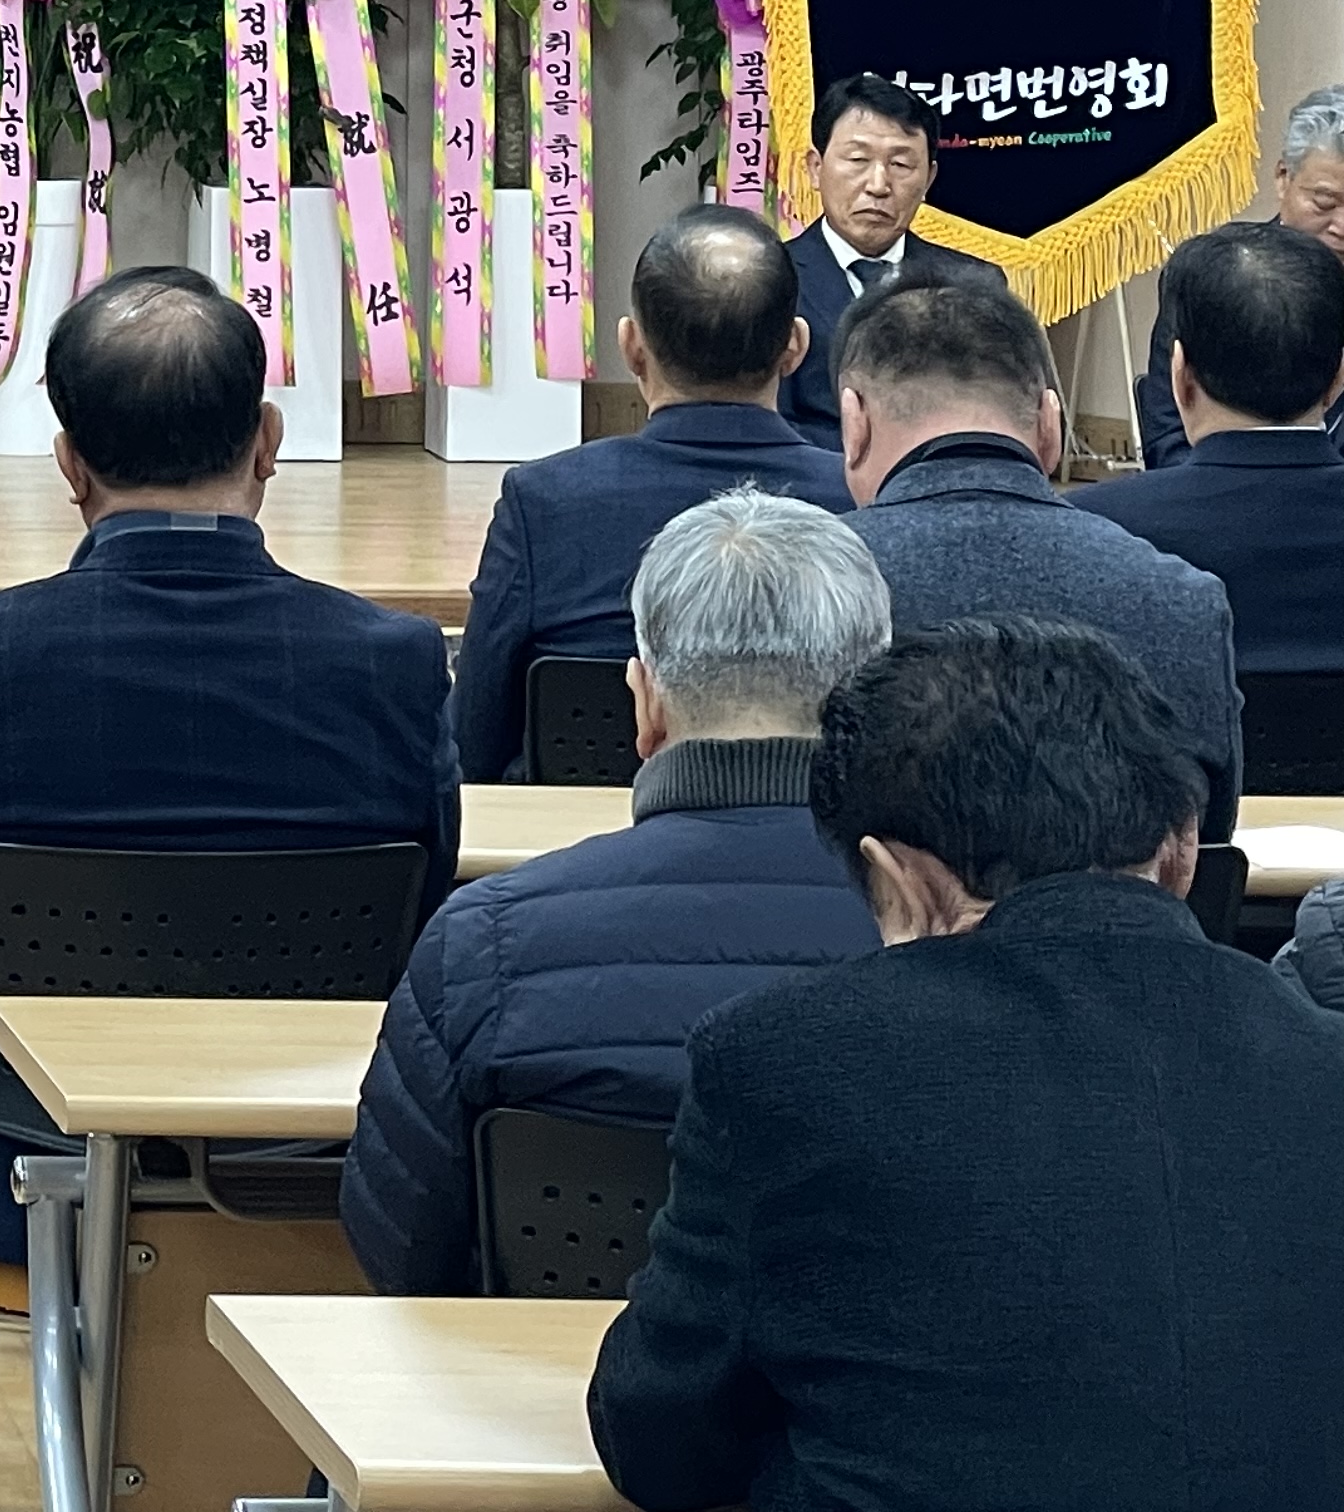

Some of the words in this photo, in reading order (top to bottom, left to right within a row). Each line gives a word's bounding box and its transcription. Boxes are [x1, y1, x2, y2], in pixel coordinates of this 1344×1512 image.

[544, 29, 578, 115] 취임을
[732, 50, 770, 193] 광주타임즈
[545, 133, 579, 305] 축하드립니다
